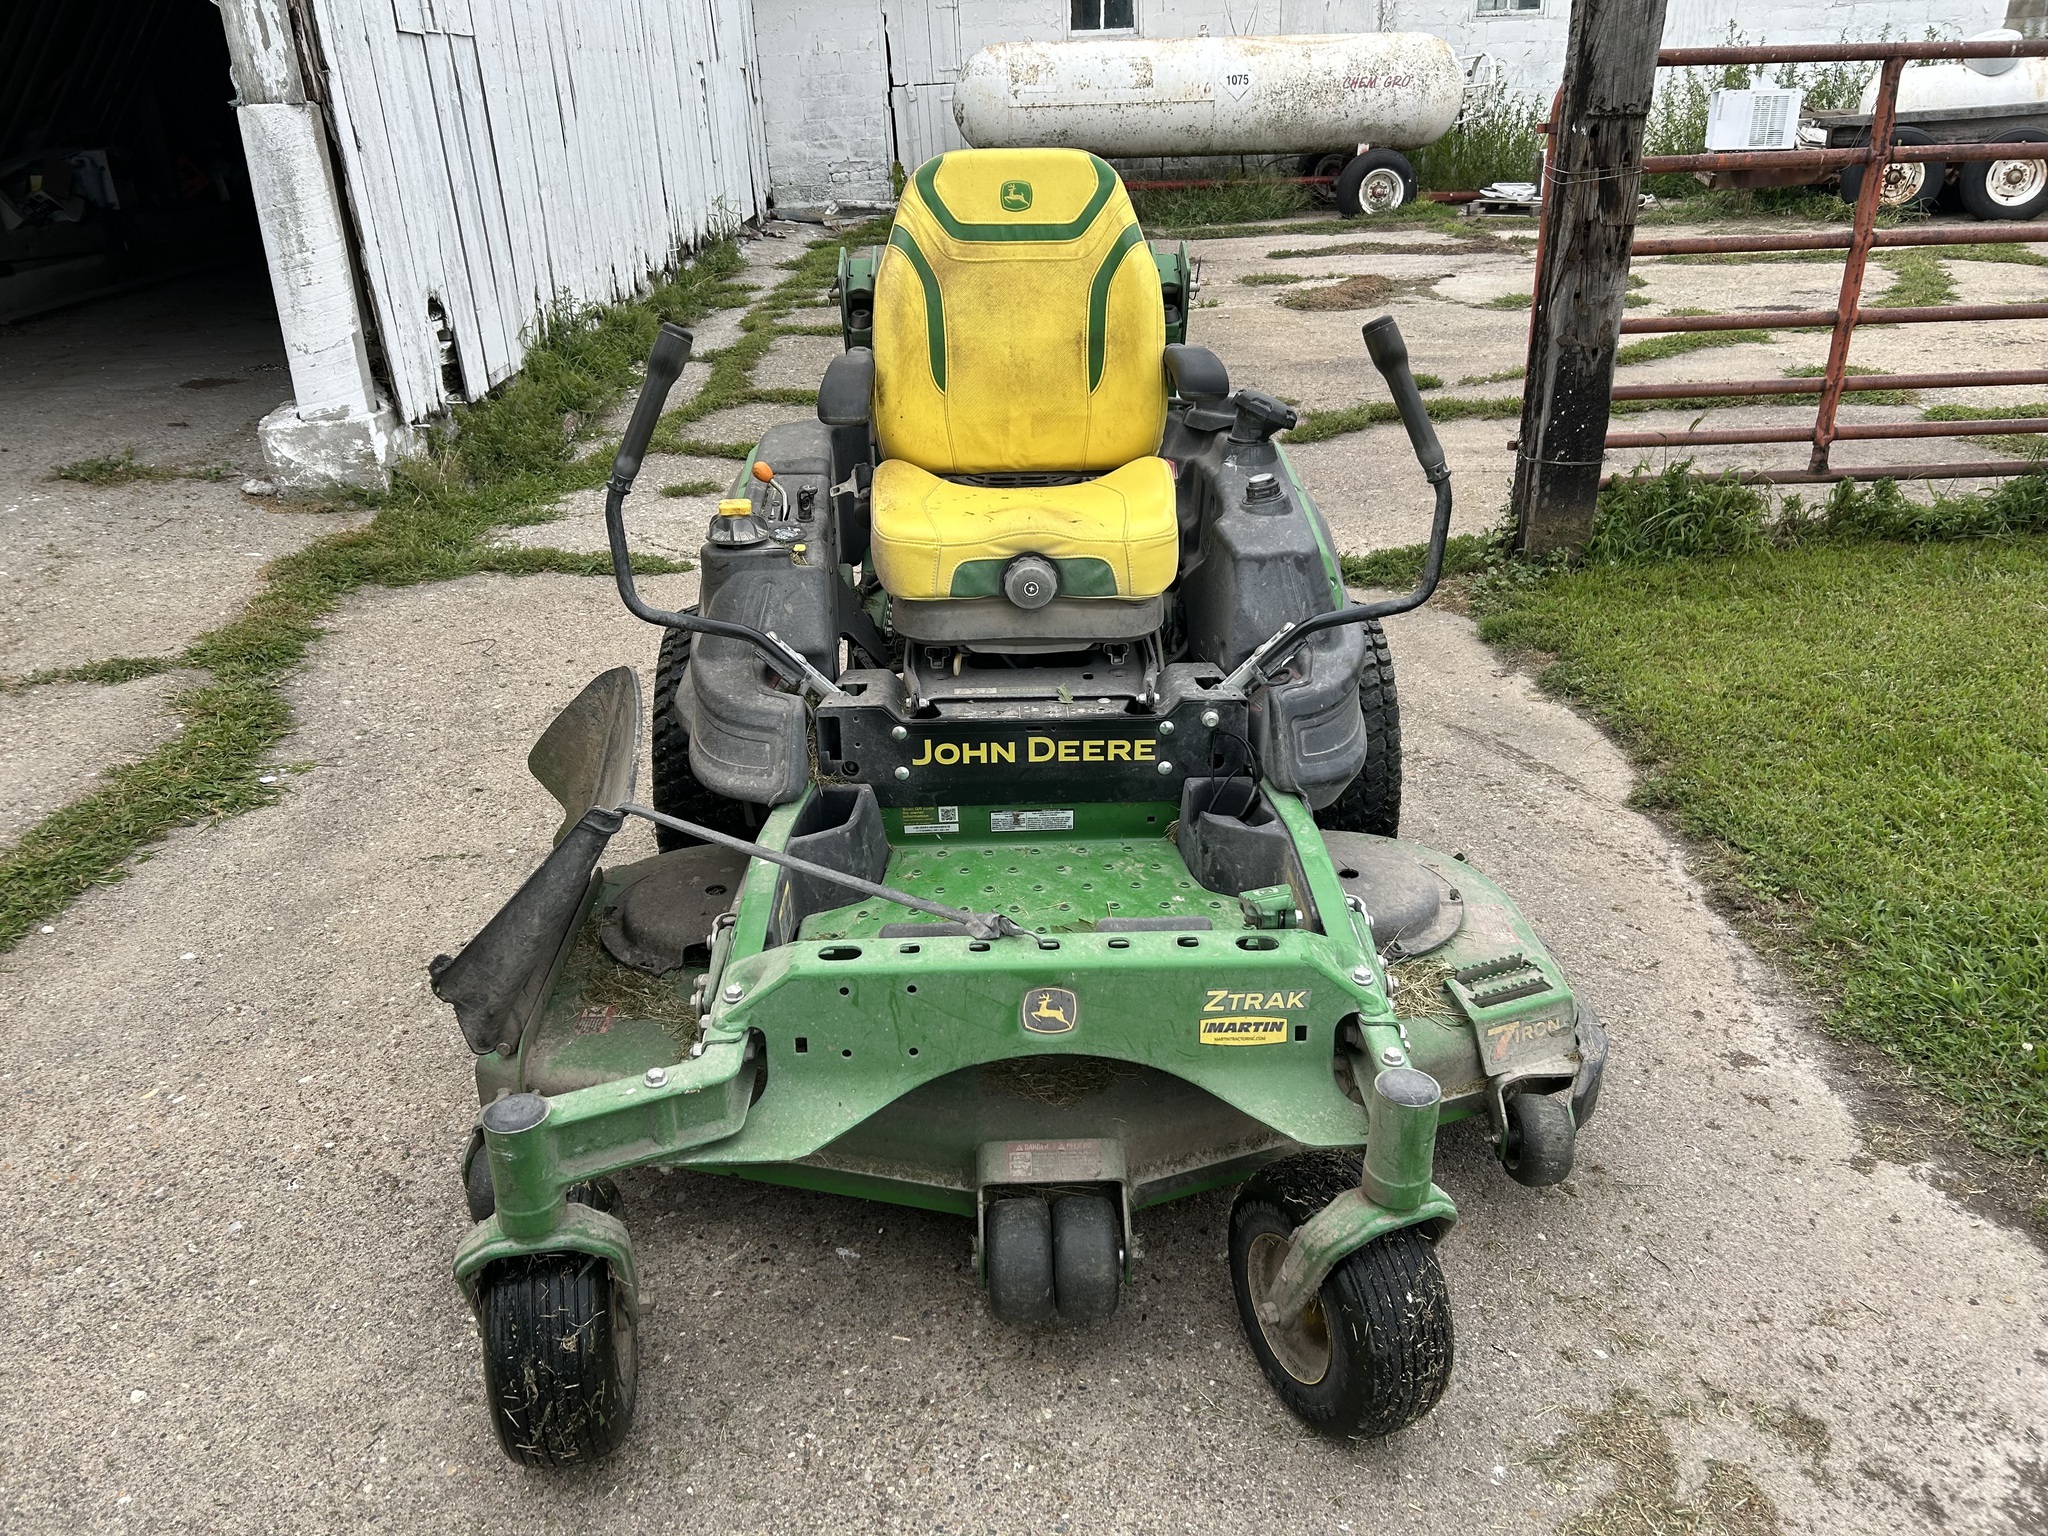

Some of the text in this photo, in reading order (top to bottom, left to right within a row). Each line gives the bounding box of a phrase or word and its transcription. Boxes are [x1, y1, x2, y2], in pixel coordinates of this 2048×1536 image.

[1226, 74, 1249, 86] 1075
[1342, 75, 1411, 90] CHEM GRO
[1203, 1021, 1285, 1033] MARTIN
